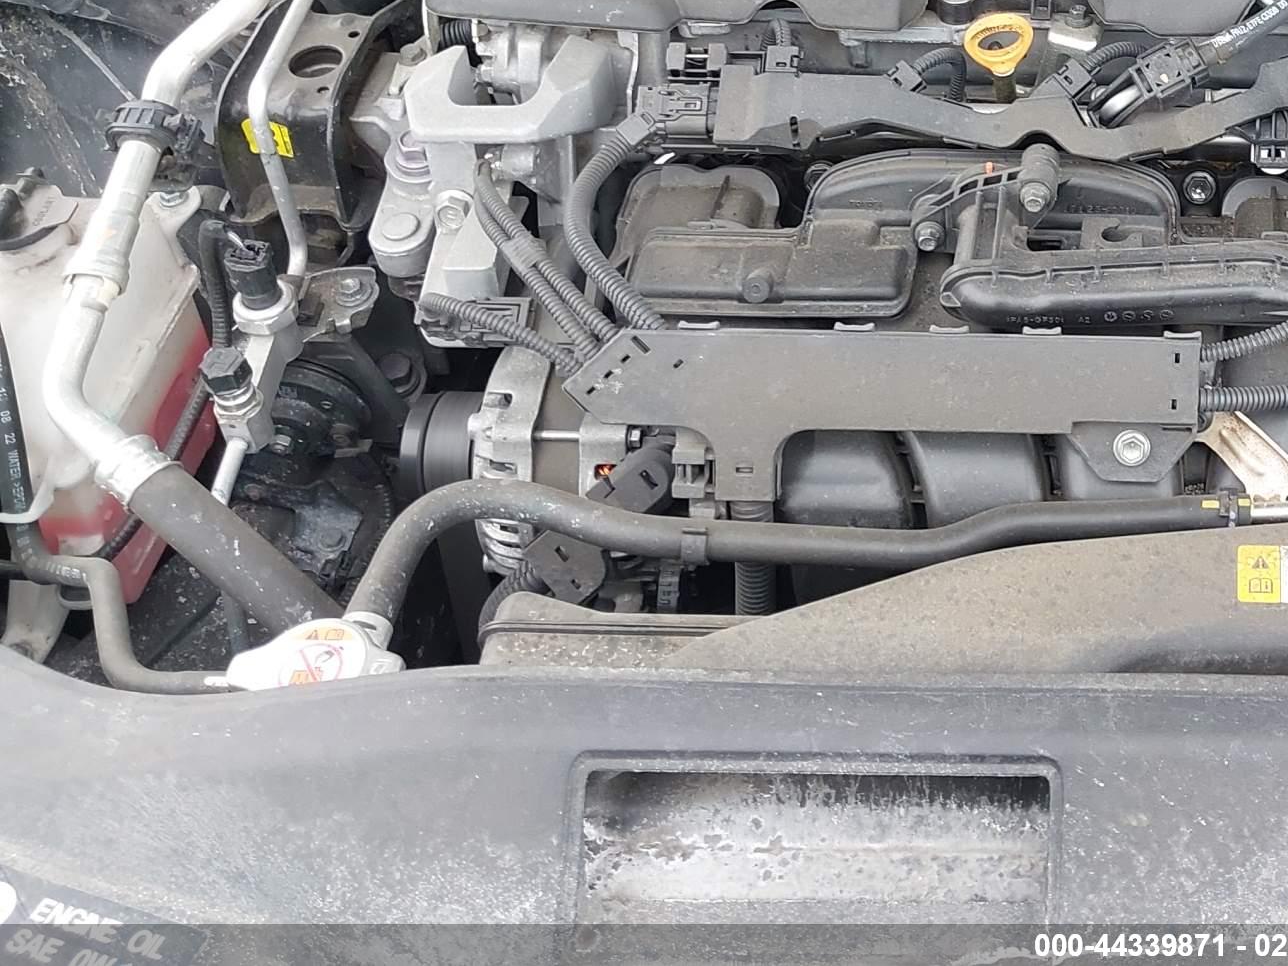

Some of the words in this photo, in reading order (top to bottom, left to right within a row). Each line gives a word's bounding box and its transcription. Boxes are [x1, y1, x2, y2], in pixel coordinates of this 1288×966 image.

[4, 432, 17, 445] 22
[5, 928, 65, 963] SAE
[127, 929, 166, 960] OIL
